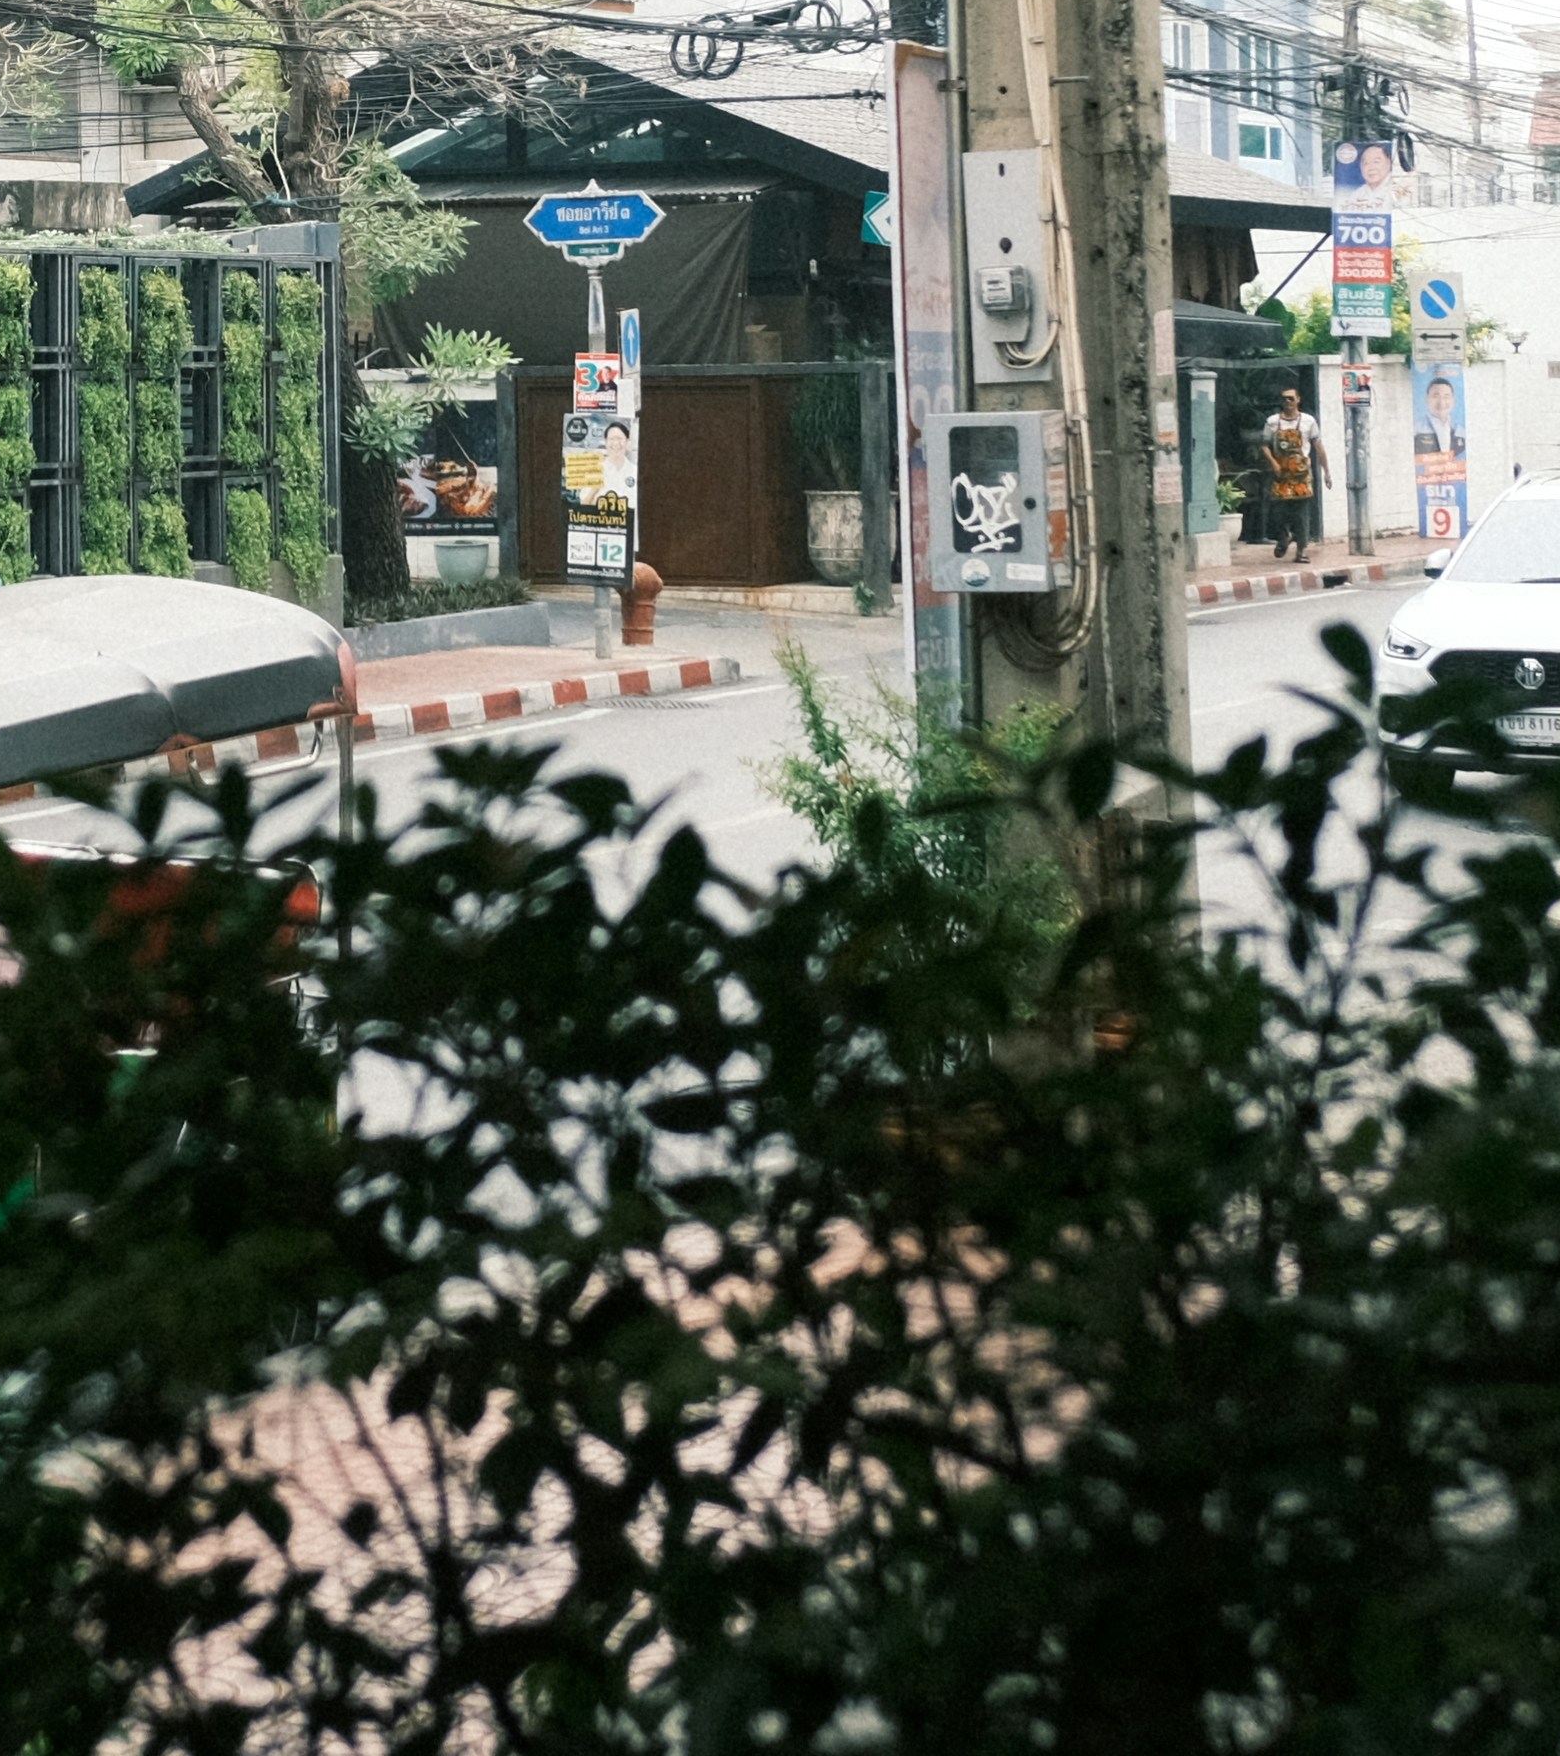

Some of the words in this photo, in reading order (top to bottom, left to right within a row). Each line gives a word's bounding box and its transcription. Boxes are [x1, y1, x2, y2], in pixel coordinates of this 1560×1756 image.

[556, 201, 619, 222] ซอยอารีย์
[1338, 226, 1386, 243] 700
[577, 361, 599, 392] 3
[598, 491, 627, 514] คริส
[1433, 508, 1451, 536] 9
[599, 543, 623, 563] 12
